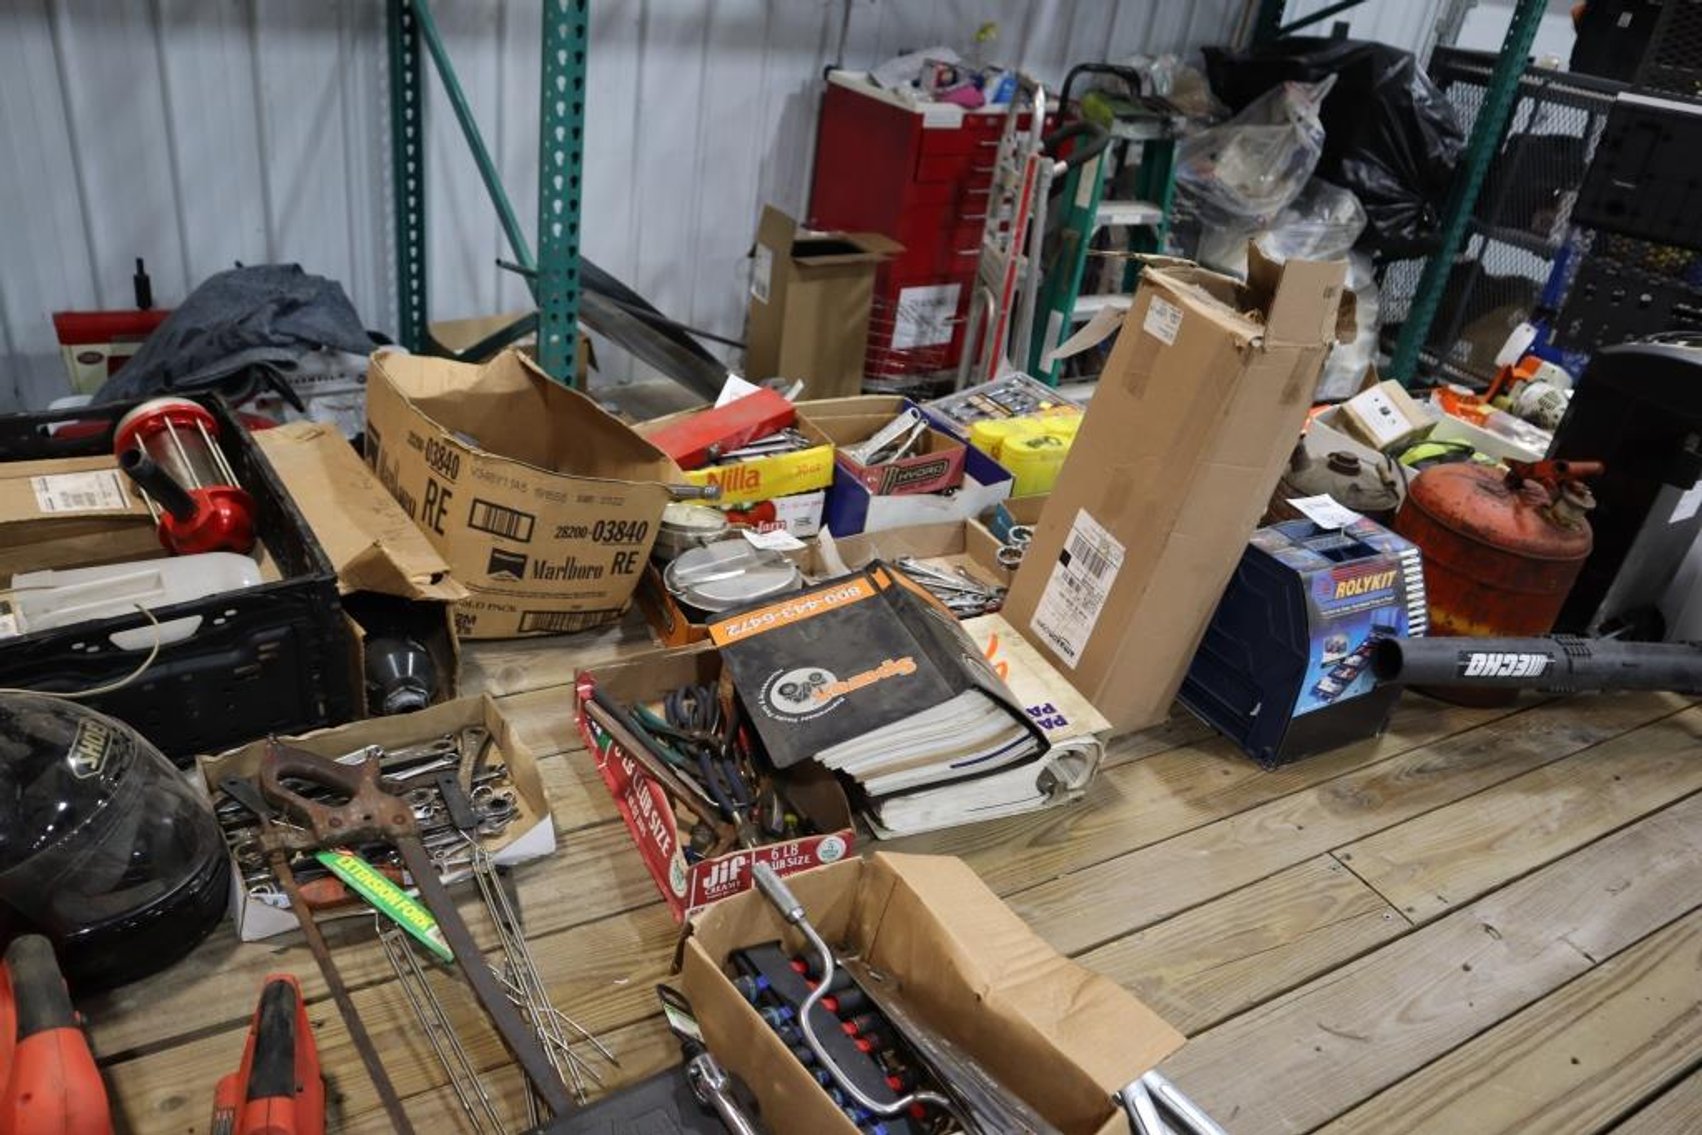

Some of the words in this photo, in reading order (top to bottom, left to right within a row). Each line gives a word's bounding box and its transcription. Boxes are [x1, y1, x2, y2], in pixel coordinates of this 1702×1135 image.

[706, 464, 760, 492] Nilla
[421, 477, 453, 536] RE
[533, 556, 604, 581] Marlboro
[611, 551, 640, 575] RE
[1335, 569, 1398, 600] ROLYKIT
[1464, 653, 1541, 677] ECHO
[648, 810, 672, 858] SIZE
[783, 844, 800, 858] LB
[787, 854, 812, 868] SIZE
[702, 855, 747, 889] Jif
